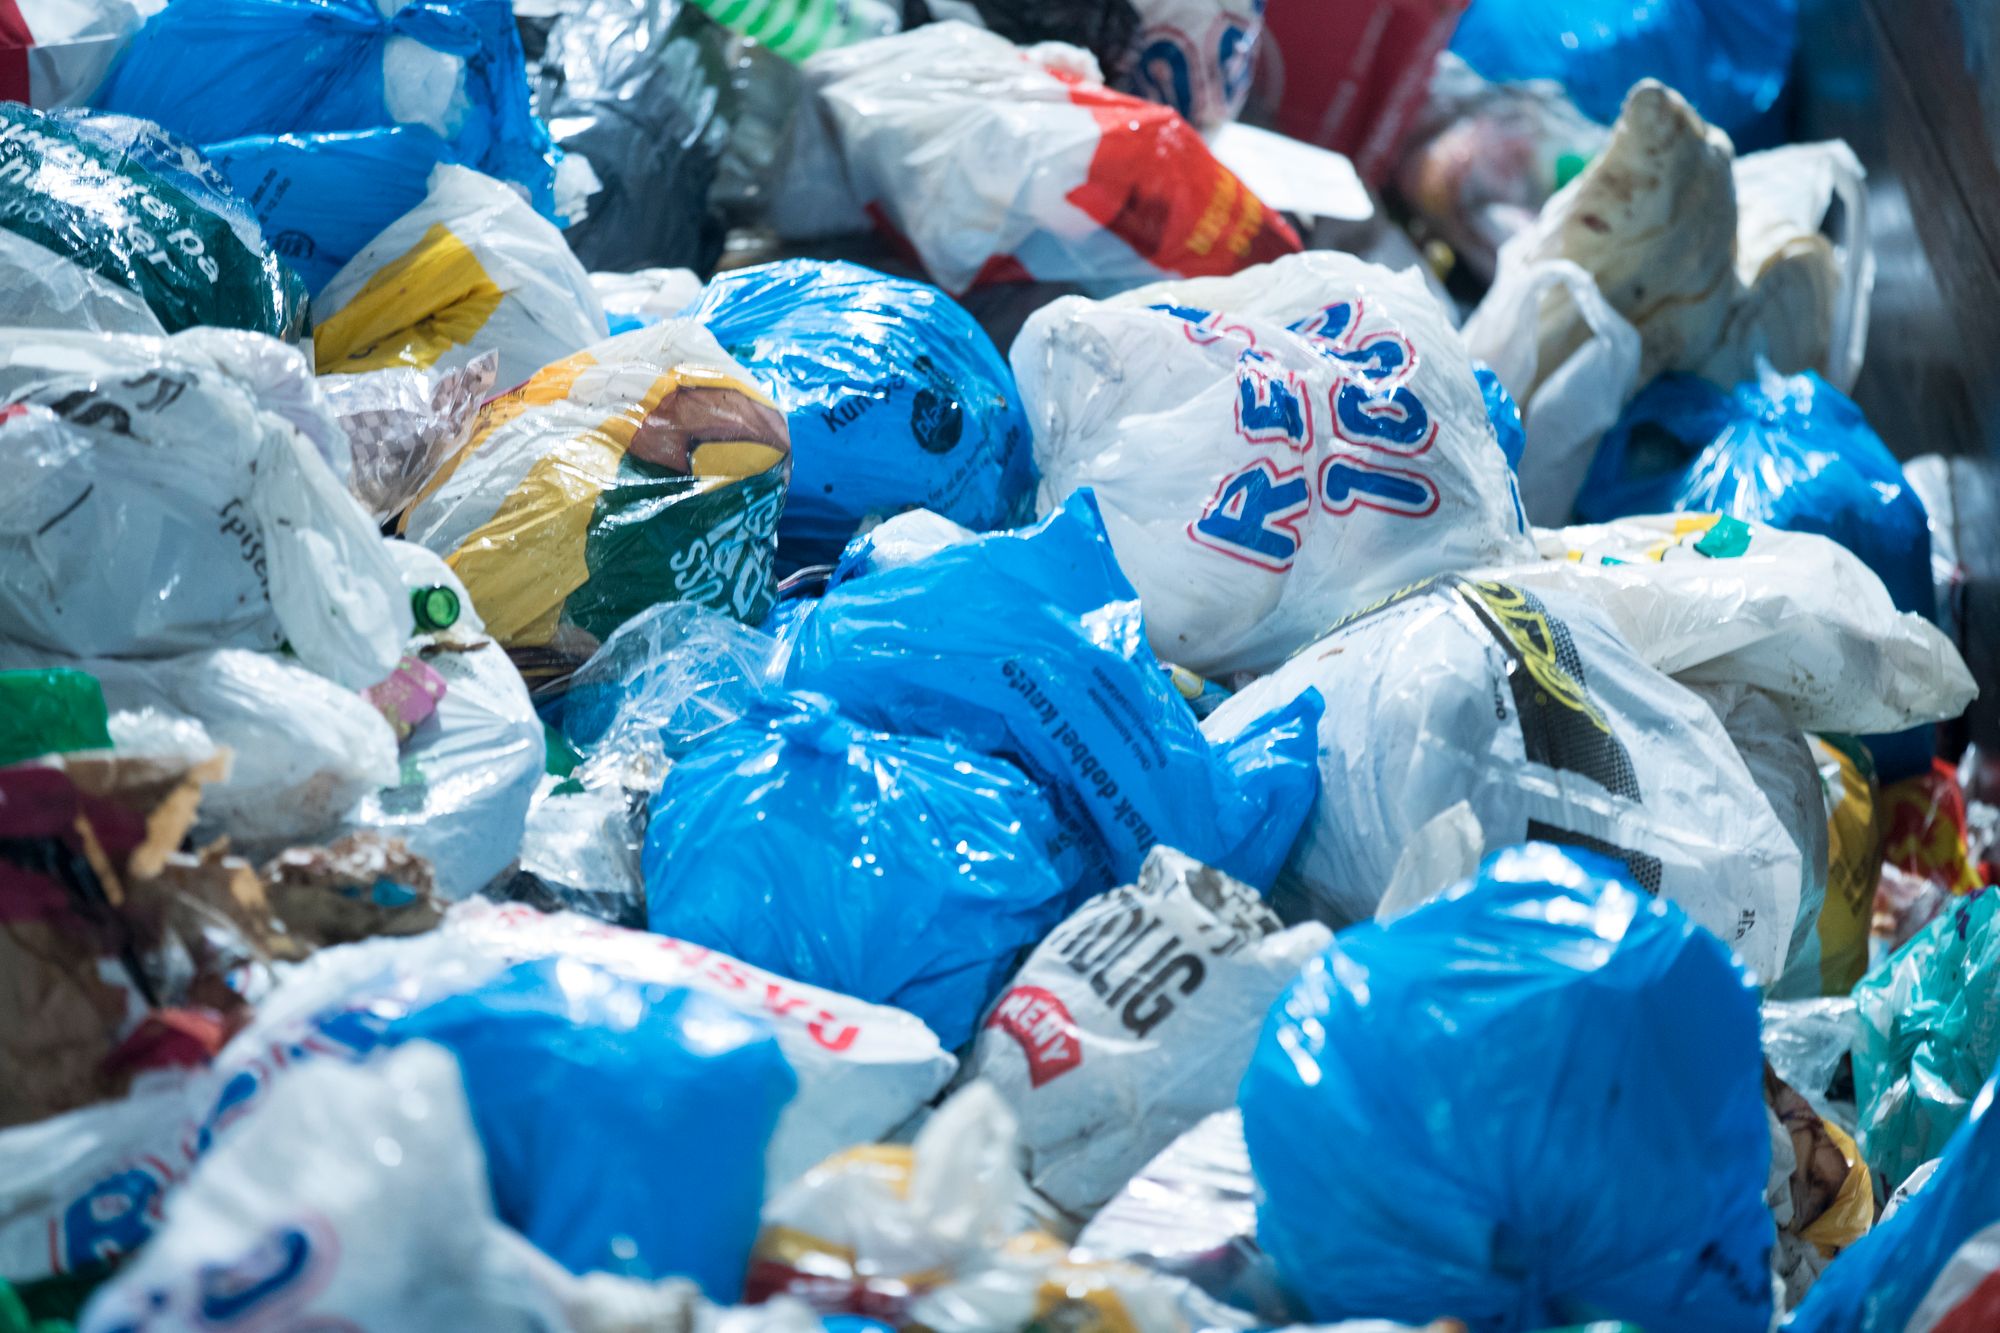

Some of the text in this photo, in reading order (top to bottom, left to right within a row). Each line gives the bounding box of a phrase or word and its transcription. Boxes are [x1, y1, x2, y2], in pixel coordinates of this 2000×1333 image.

[1002, 659, 1059, 725] knute
[1052, 720, 1119, 799] dobbel
[999, 994, 1070, 1063] MENY
